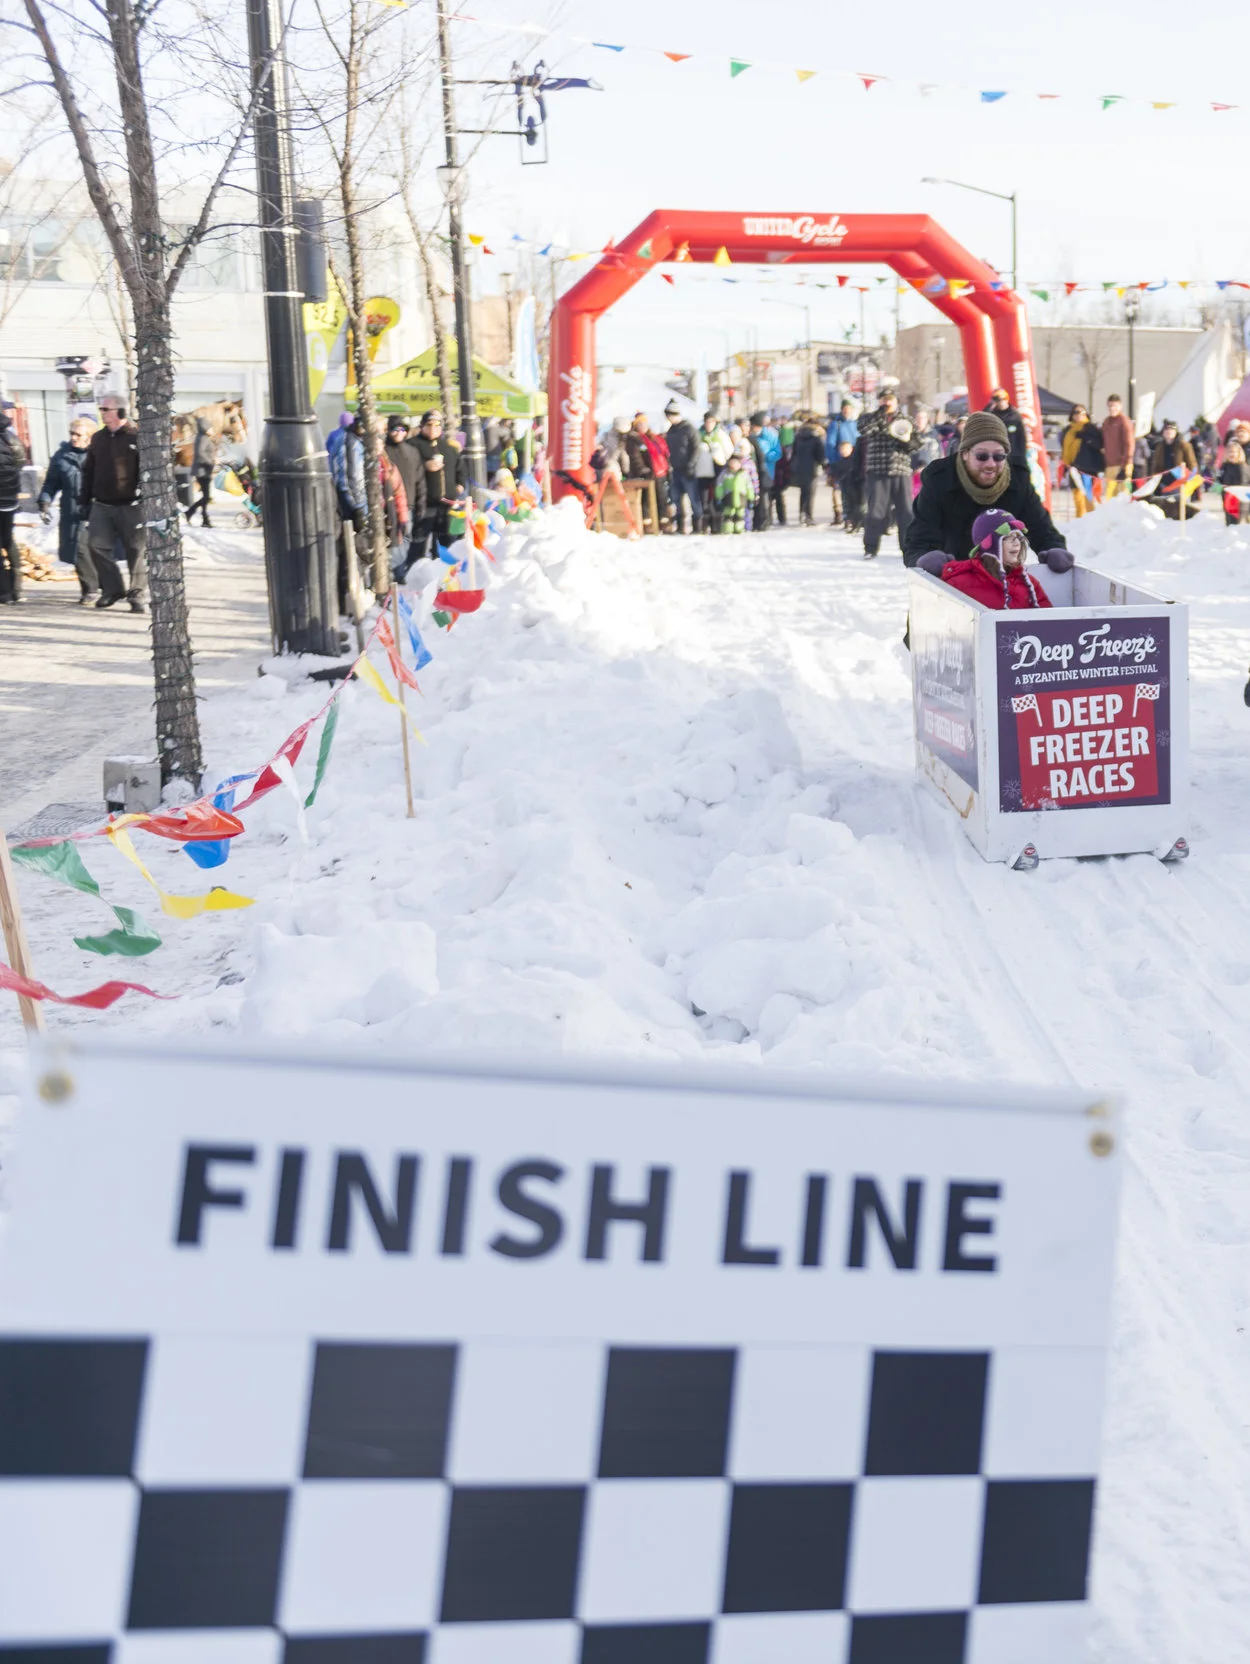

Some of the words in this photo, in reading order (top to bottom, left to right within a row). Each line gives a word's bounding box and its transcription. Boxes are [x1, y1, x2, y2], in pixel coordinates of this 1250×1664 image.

[1011, 635, 1074, 670] Deep
[1078, 623, 1157, 664] Freeze
[1015, 675, 1021, 685] A
[1022, 669, 1079, 685] BYZANTINE
[1079, 666, 1120, 680] WINTER
[1120, 664, 1158, 676] FESTIVAL
[1052, 693, 1124, 728] DEEP
[1029, 726, 1150, 766] FREEZER
[1049, 762, 1135, 799] RACES
[173, 1140, 673, 1266] FINISH
[720, 1168, 1003, 1273] LINE
